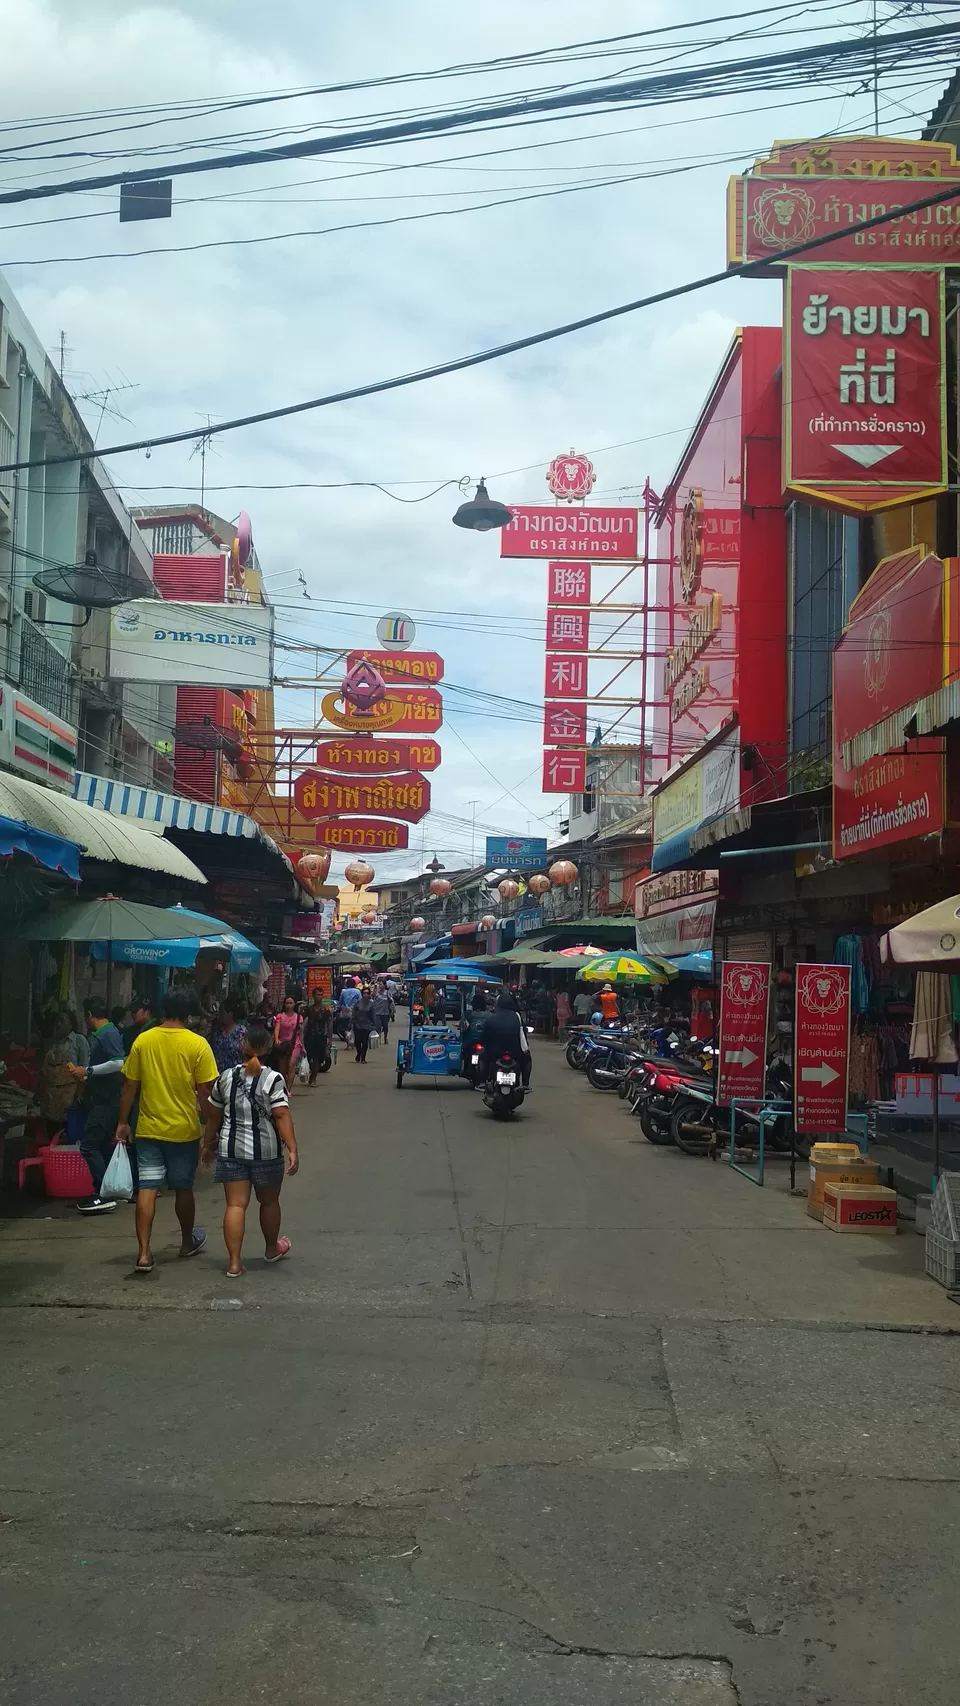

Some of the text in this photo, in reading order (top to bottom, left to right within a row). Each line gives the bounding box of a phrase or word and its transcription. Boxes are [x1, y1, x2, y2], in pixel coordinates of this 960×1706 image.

[802, 294, 930, 337] ย้ายมา
[839, 348, 897, 405] ที่นี่
[808, 413, 926, 436] (ที่ทำการชั่วคราว)
[530, 537, 618, 552] ตราสิงห์ทอง
[153, 629, 257, 646] อาหารทะเล
[327, 743, 401, 765] ห้างทอง
[324, 826, 400, 847] เยาวราช
[801, 1021, 845, 1031] ห้างทองวัฒนา
[798, 1046, 847, 1058] เชิญด้านนี้ค่ะ
